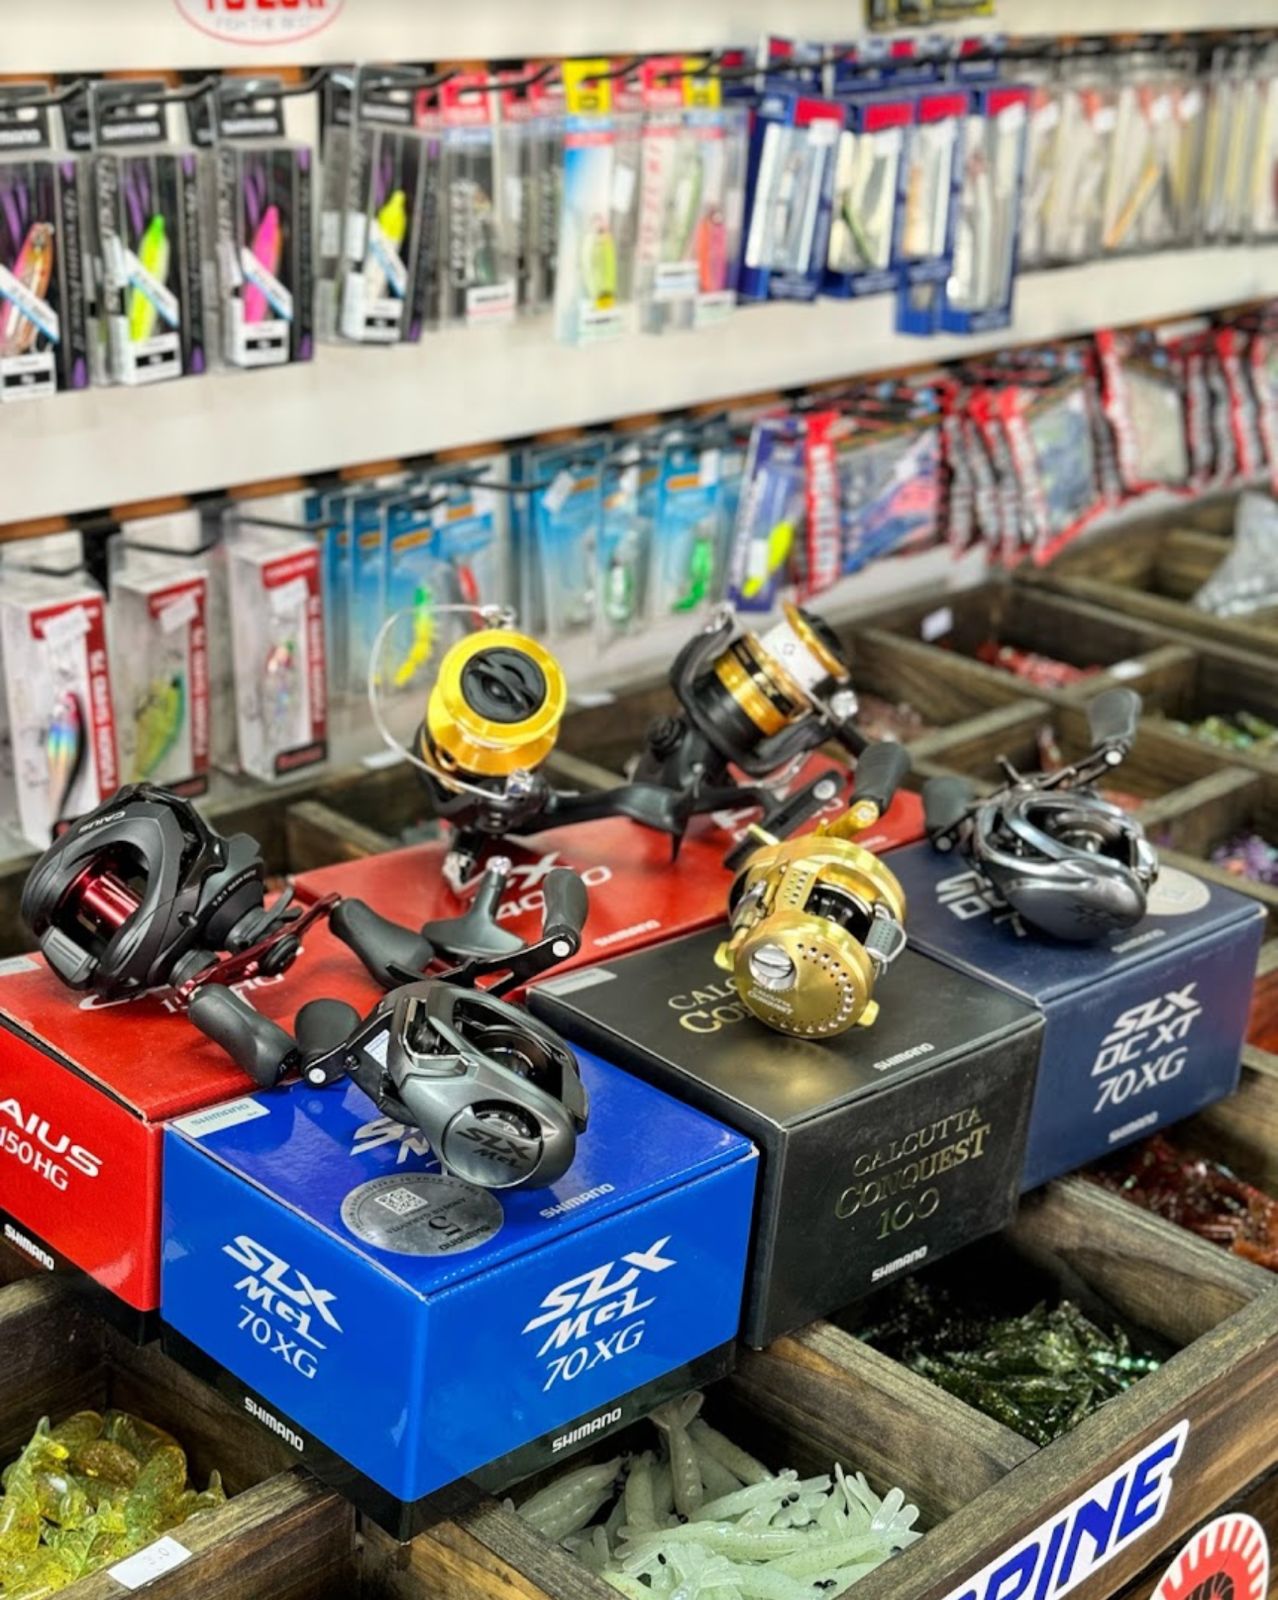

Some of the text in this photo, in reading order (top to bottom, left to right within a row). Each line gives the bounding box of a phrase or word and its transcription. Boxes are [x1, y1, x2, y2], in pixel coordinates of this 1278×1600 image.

[1101, 981, 1200, 1047] SLX
[873, 1042, 936, 1072] SHIMANO
[1090, 1006, 1203, 1077] DC XT
[455, 1127, 531, 1161] SLX
[853, 1105, 983, 1178] CALCUTTA
[834, 1123, 992, 1220] CONQUEST
[428, 1215, 463, 1237] 5
[539, 1183, 616, 1220] SHIMANO
[876, 1187, 940, 1241] 100
[4, 1223, 55, 1271] SHIMANO
[871, 1245, 929, 1283] SHIMANO
[222, 1235, 344, 1334] SLX
[521, 1234, 678, 1335] SLX
[244, 1396, 304, 1452] SHIMANO
[552, 1407, 623, 1454] SHIMANO
